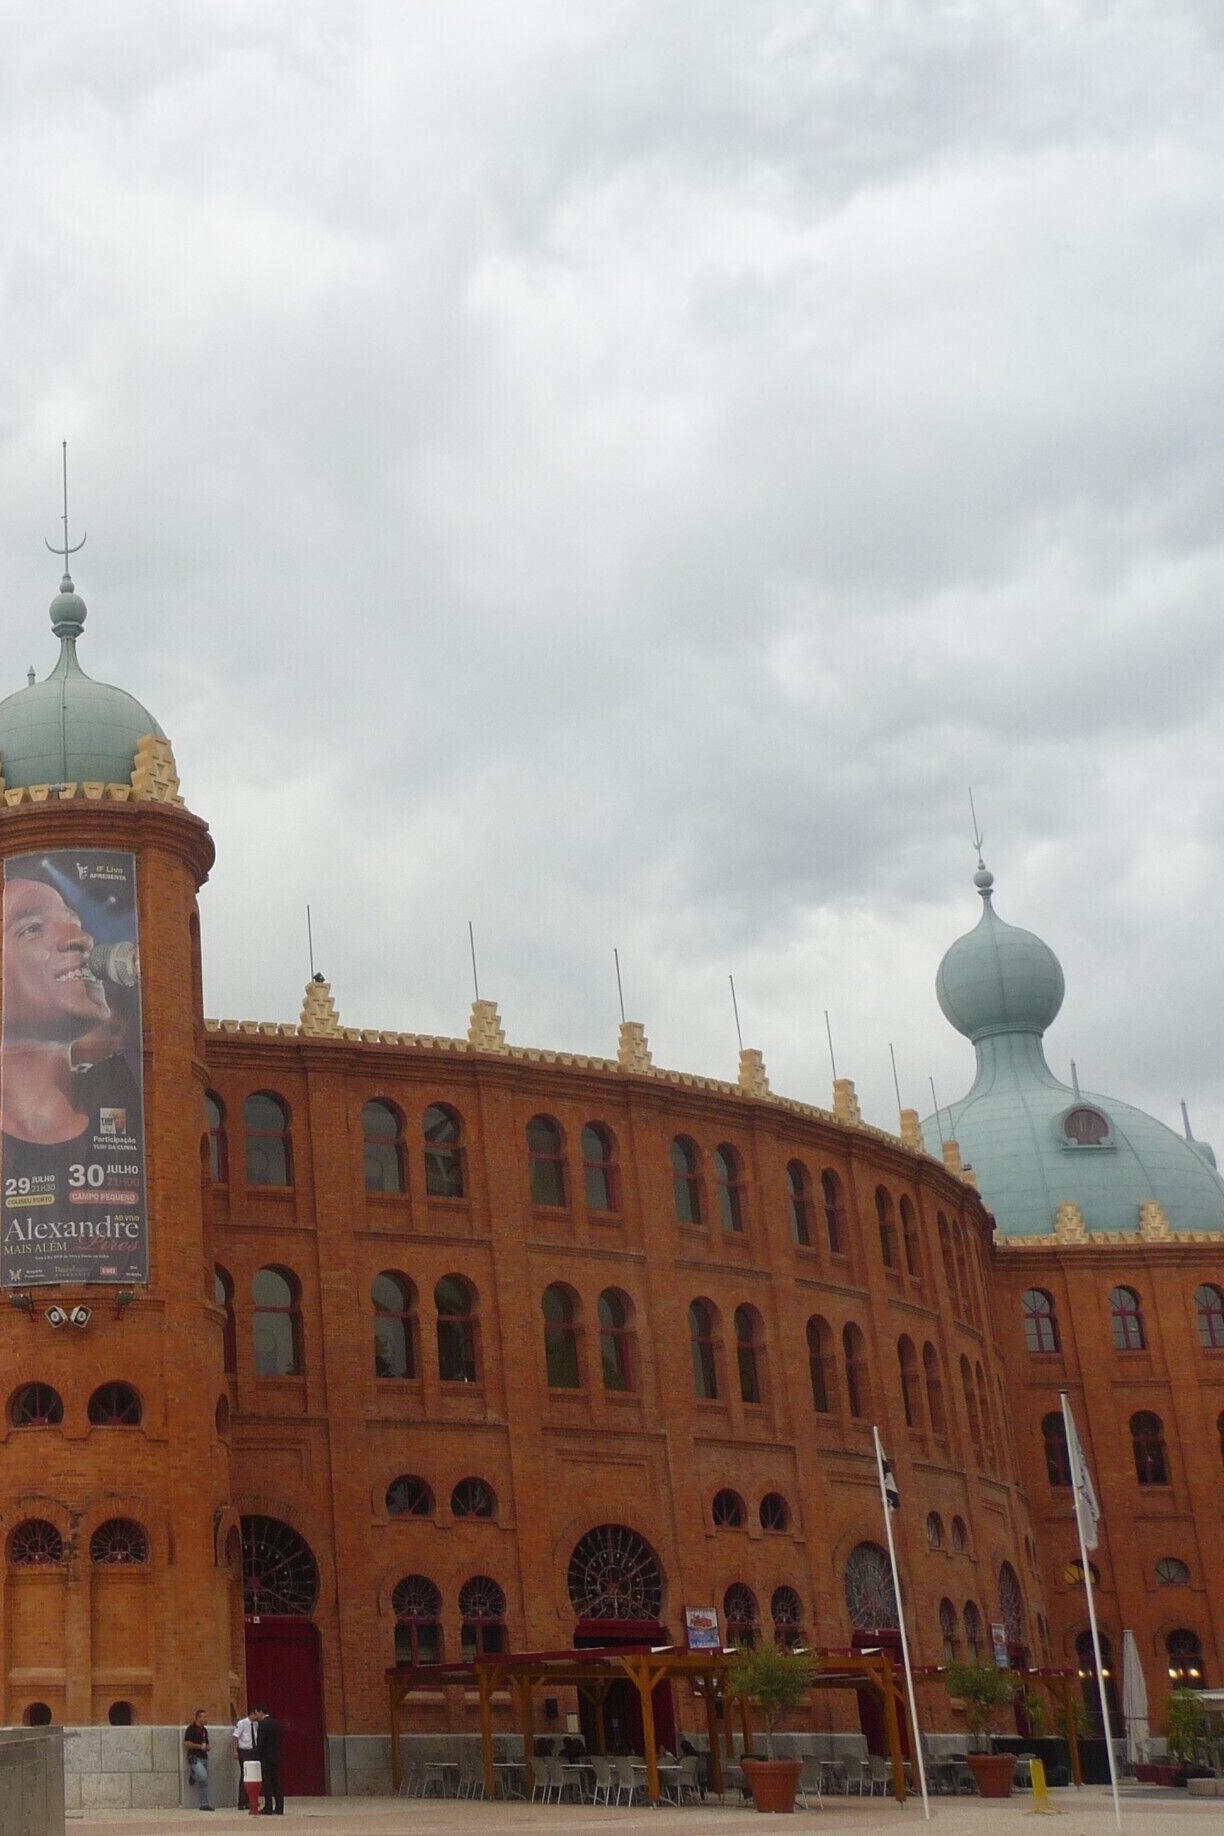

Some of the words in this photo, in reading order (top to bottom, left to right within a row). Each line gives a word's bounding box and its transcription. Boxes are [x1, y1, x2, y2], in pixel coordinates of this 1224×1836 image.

[5, 1177, 31, 1196] 29
[31, 1174, 55, 1184] JULHO
[68, 1164, 105, 1187] 30
[106, 1164, 139, 1175] JULHO
[71, 1192, 99, 1201] CAMPO
[100, 1192, 136, 1201] PEQUENO
[4, 1215, 139, 1242] Alexandre
[3, 1244, 33, 1256] MAIS
[34, 1239, 68, 1253] ALÉM
